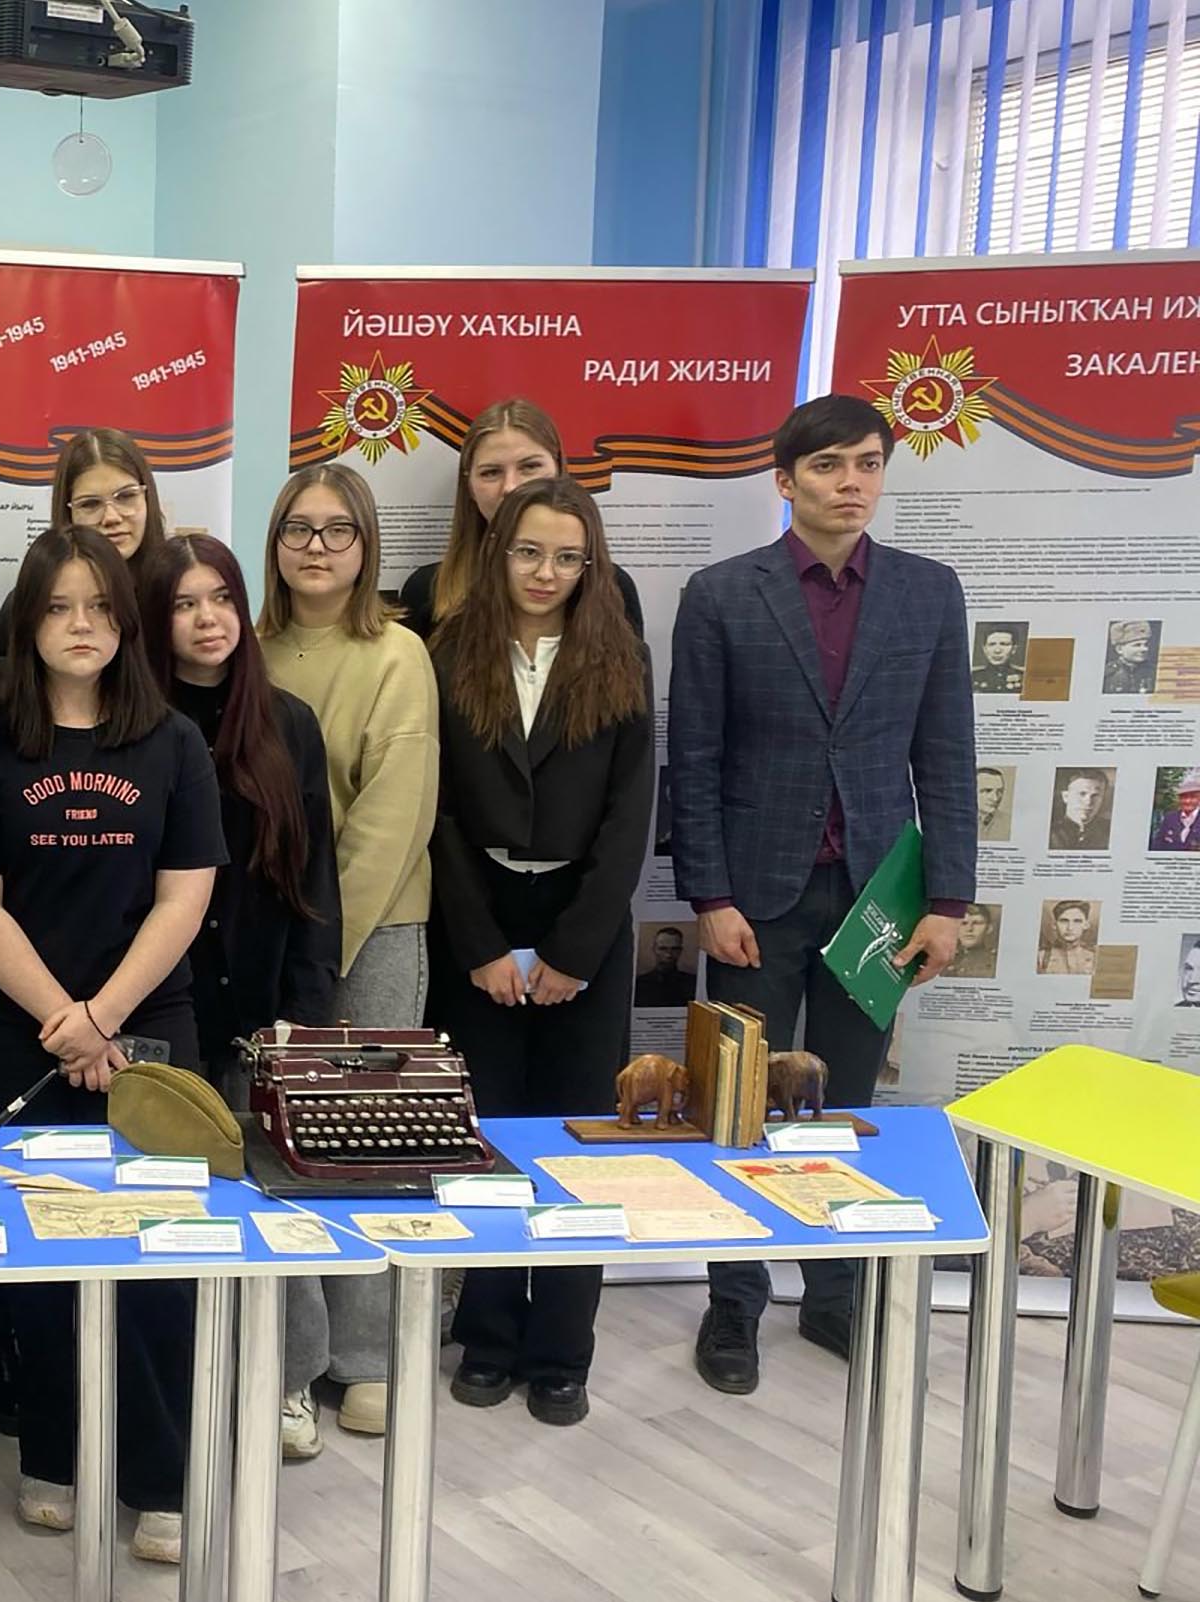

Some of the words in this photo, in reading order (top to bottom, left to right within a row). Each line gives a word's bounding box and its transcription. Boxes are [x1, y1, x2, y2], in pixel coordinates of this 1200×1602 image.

[897, 303, 968, 328] УТТА
[49, 331, 127, 373] 1941-1945
[131, 350, 207, 391] 1941-1945
[584, 360, 660, 387] РАДИ
[667, 360, 772, 382] ЖИЗНИ
[23, 774, 66, 806] GOOD
[69, 771, 141, 806] MORNING
[30, 834, 57, 846] SEE
[60, 834, 88, 846] YOU
[92, 833, 135, 845] LATER
